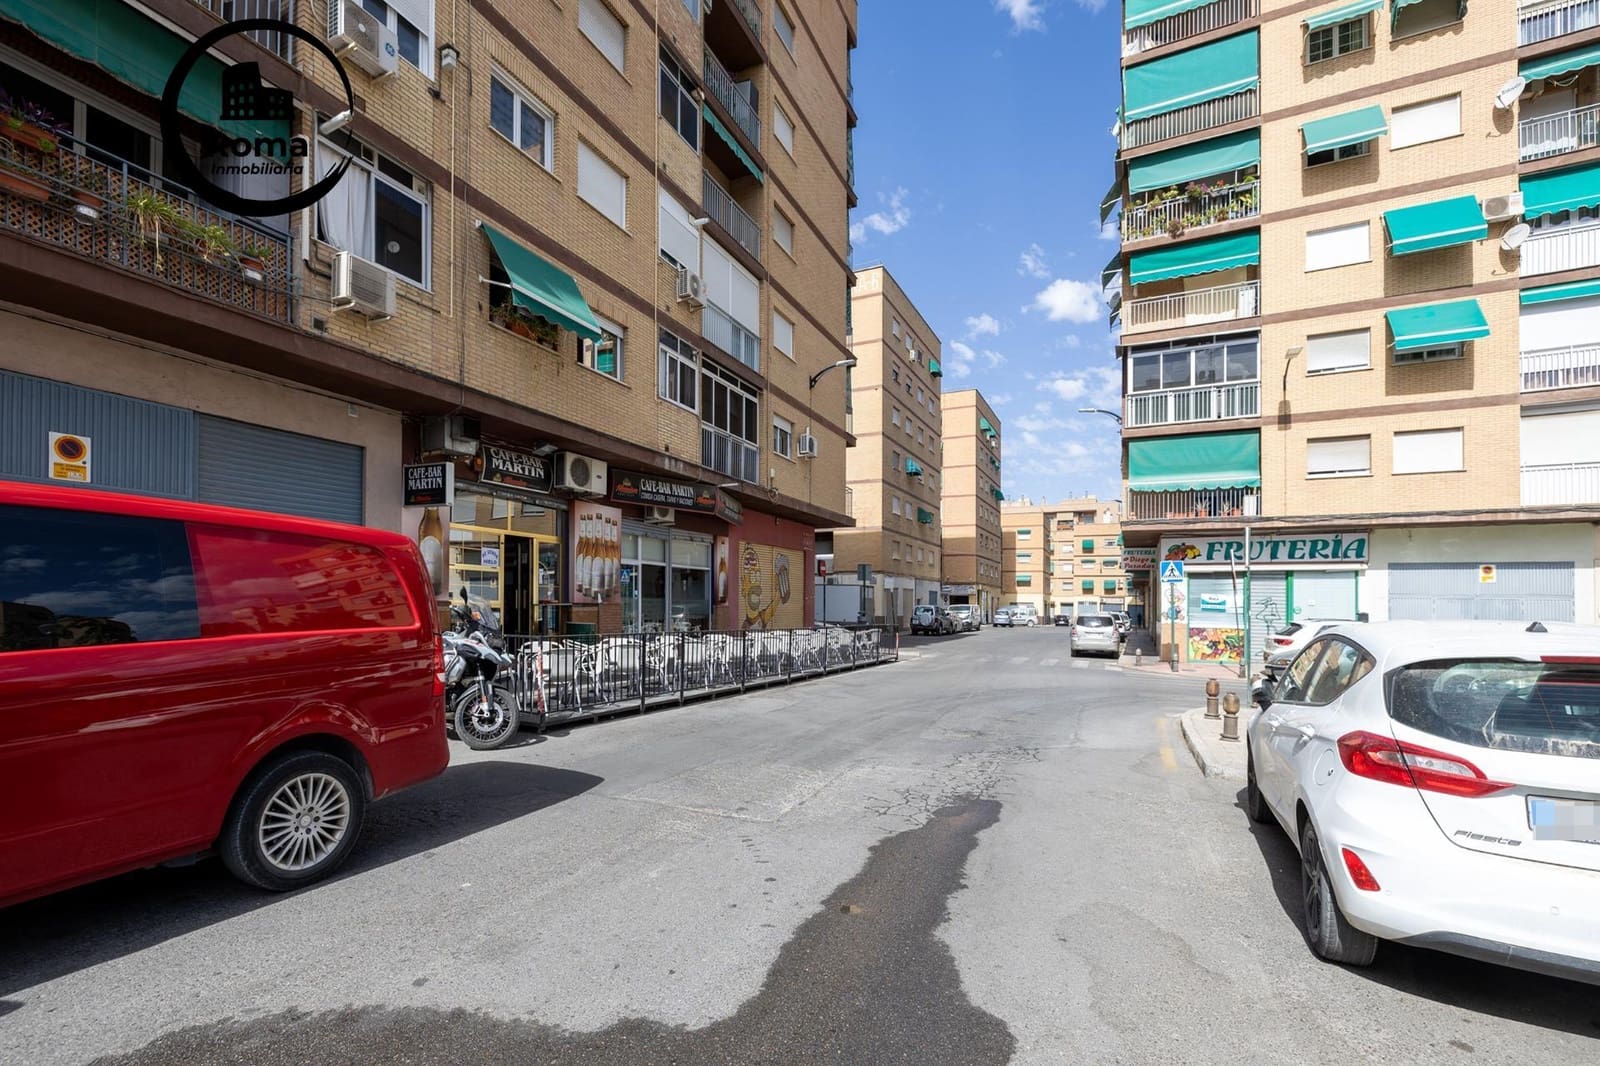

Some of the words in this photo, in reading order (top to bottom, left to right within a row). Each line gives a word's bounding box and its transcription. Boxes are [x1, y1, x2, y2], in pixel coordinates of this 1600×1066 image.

[490, 448, 543, 469] CAFE-BAR
[491, 457, 545, 480] MARTIN
[408, 465, 442, 479] CAFE-BAR
[408, 477, 443, 491] MARTIN
[640, 478, 671, 496] CAFE-BAR
[672, 483, 694, 498] MARTIN
[1206, 534, 1367, 561] FRUTERÍA
[1454, 830, 1522, 847] Fiesta
